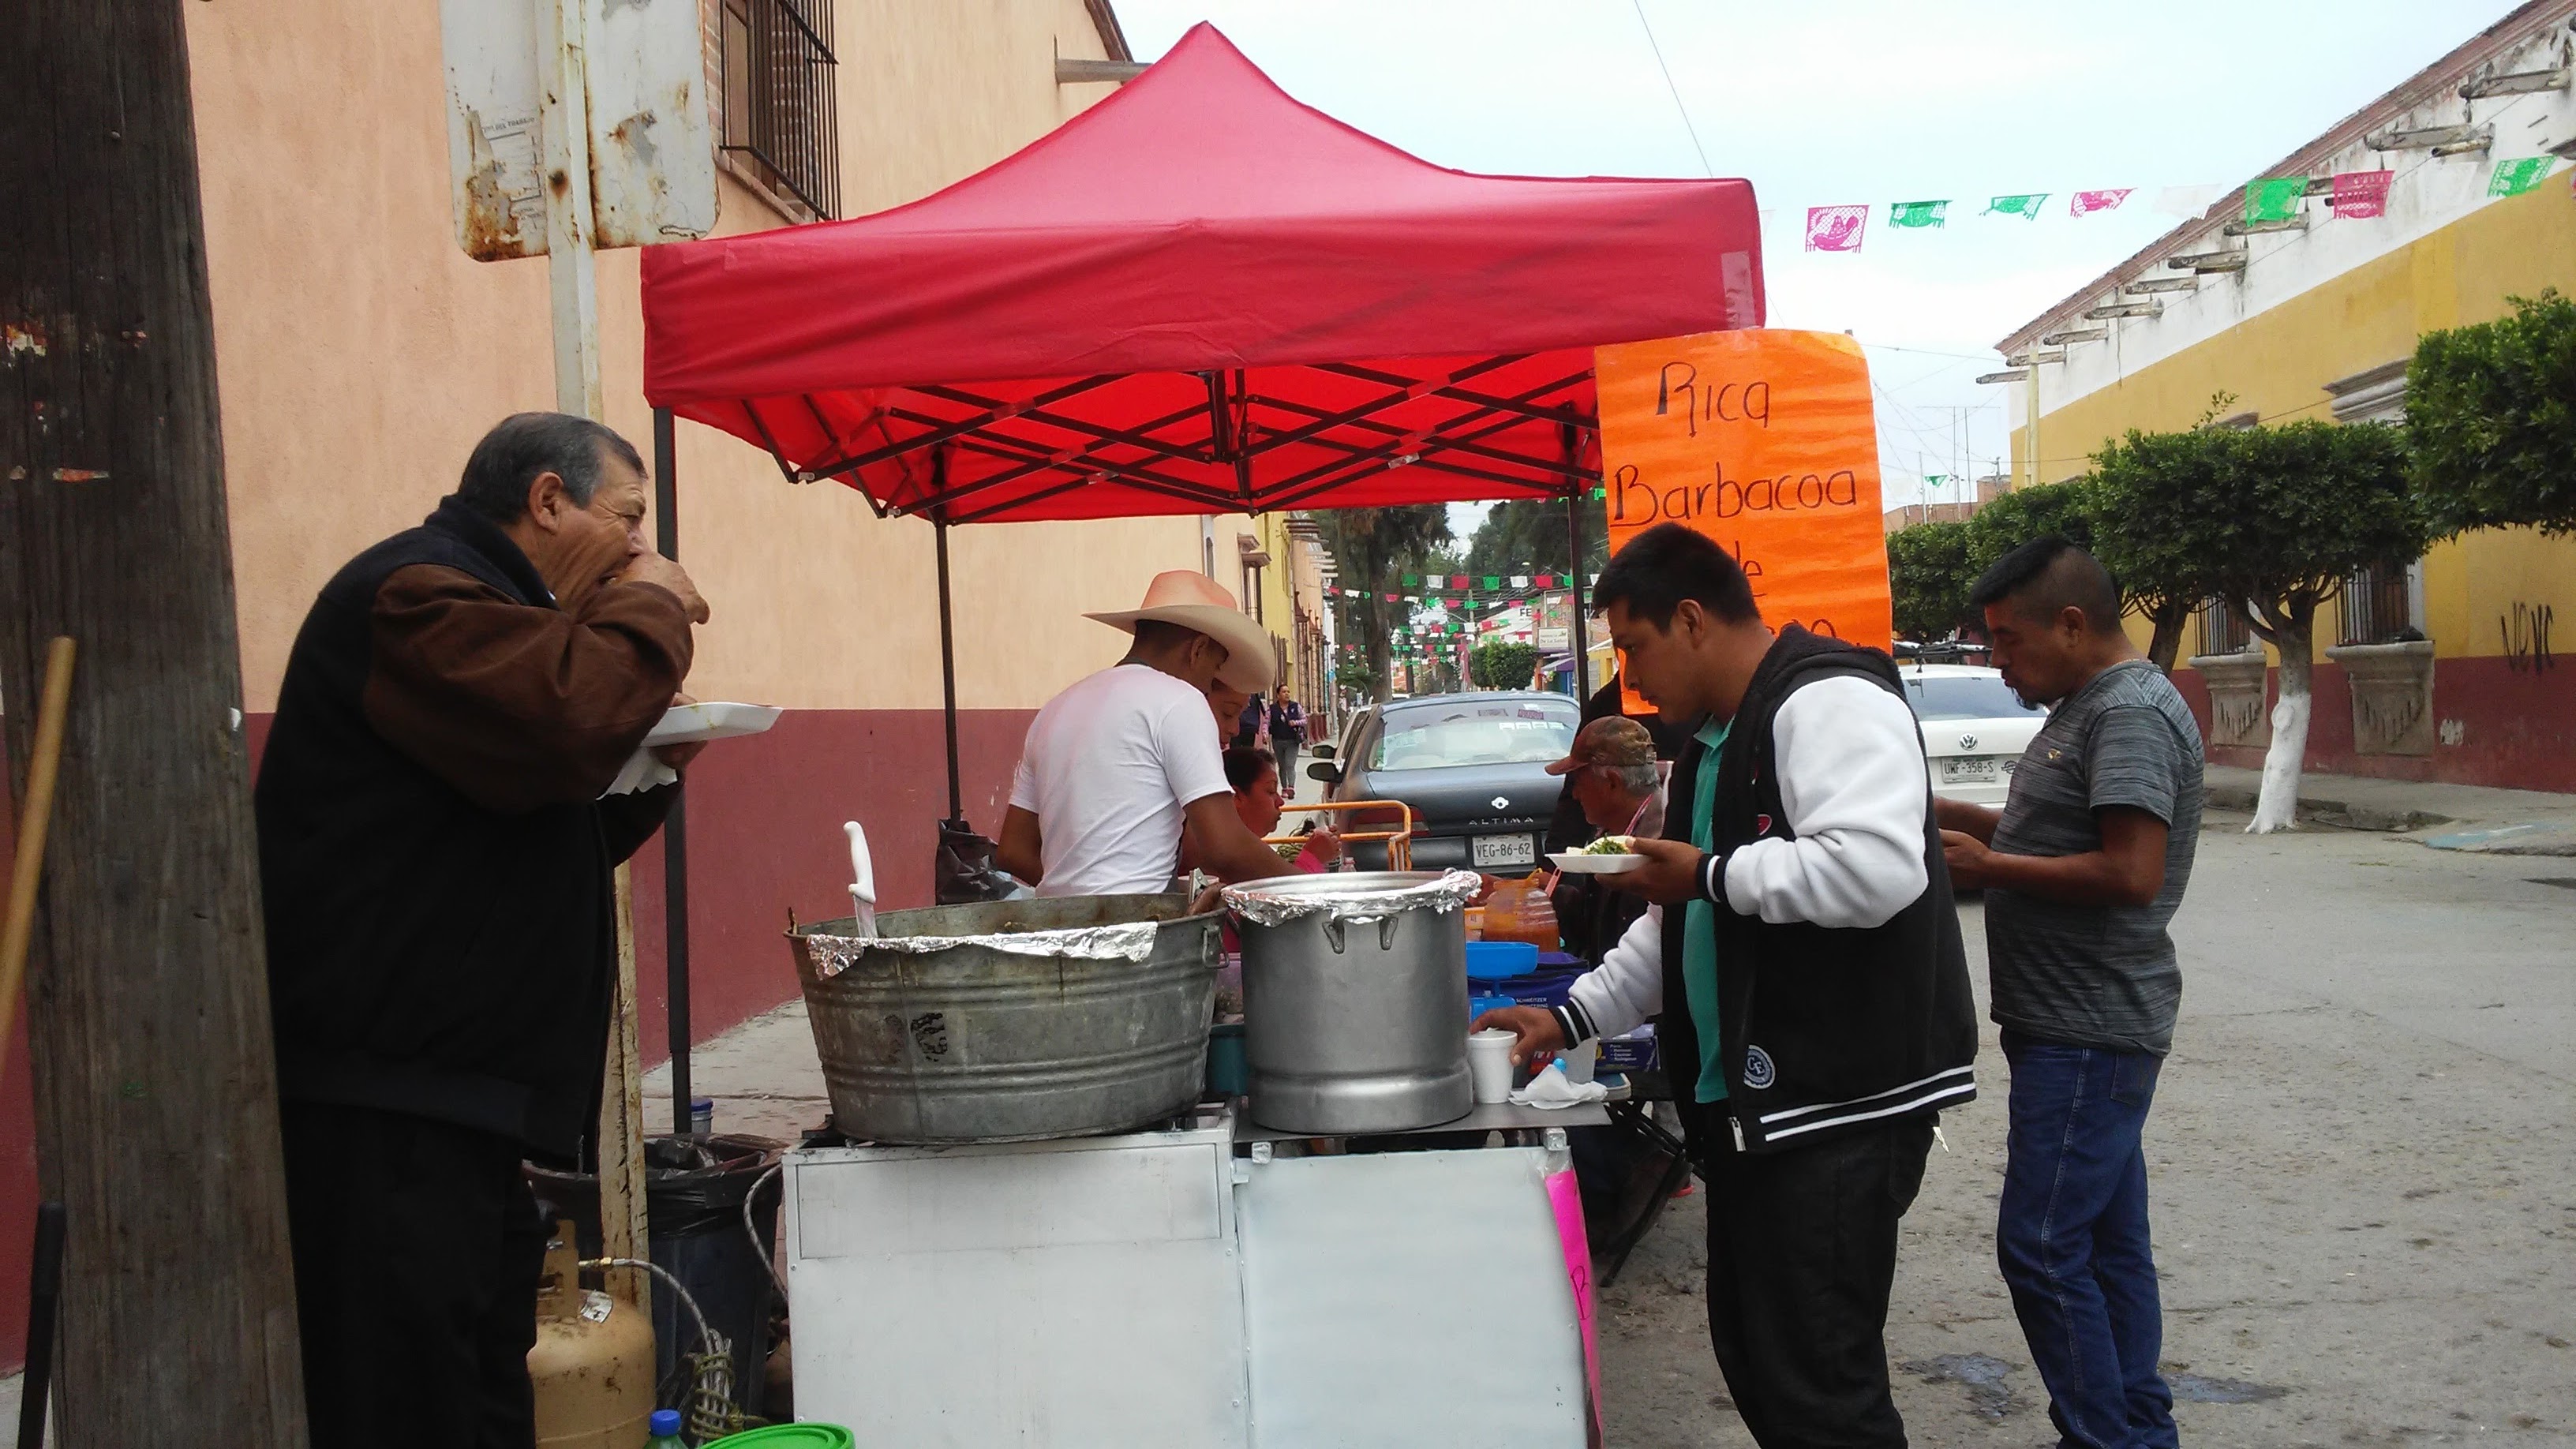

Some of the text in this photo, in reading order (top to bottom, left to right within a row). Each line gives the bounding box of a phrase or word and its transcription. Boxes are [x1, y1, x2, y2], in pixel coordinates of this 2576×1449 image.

[1656, 361, 1769, 437] Rica
[1610, 462, 1857, 527] Barbacoa
[1469, 816, 1534, 826] ALTIMA
[1475, 842, 1532, 859] VEG-86-62
